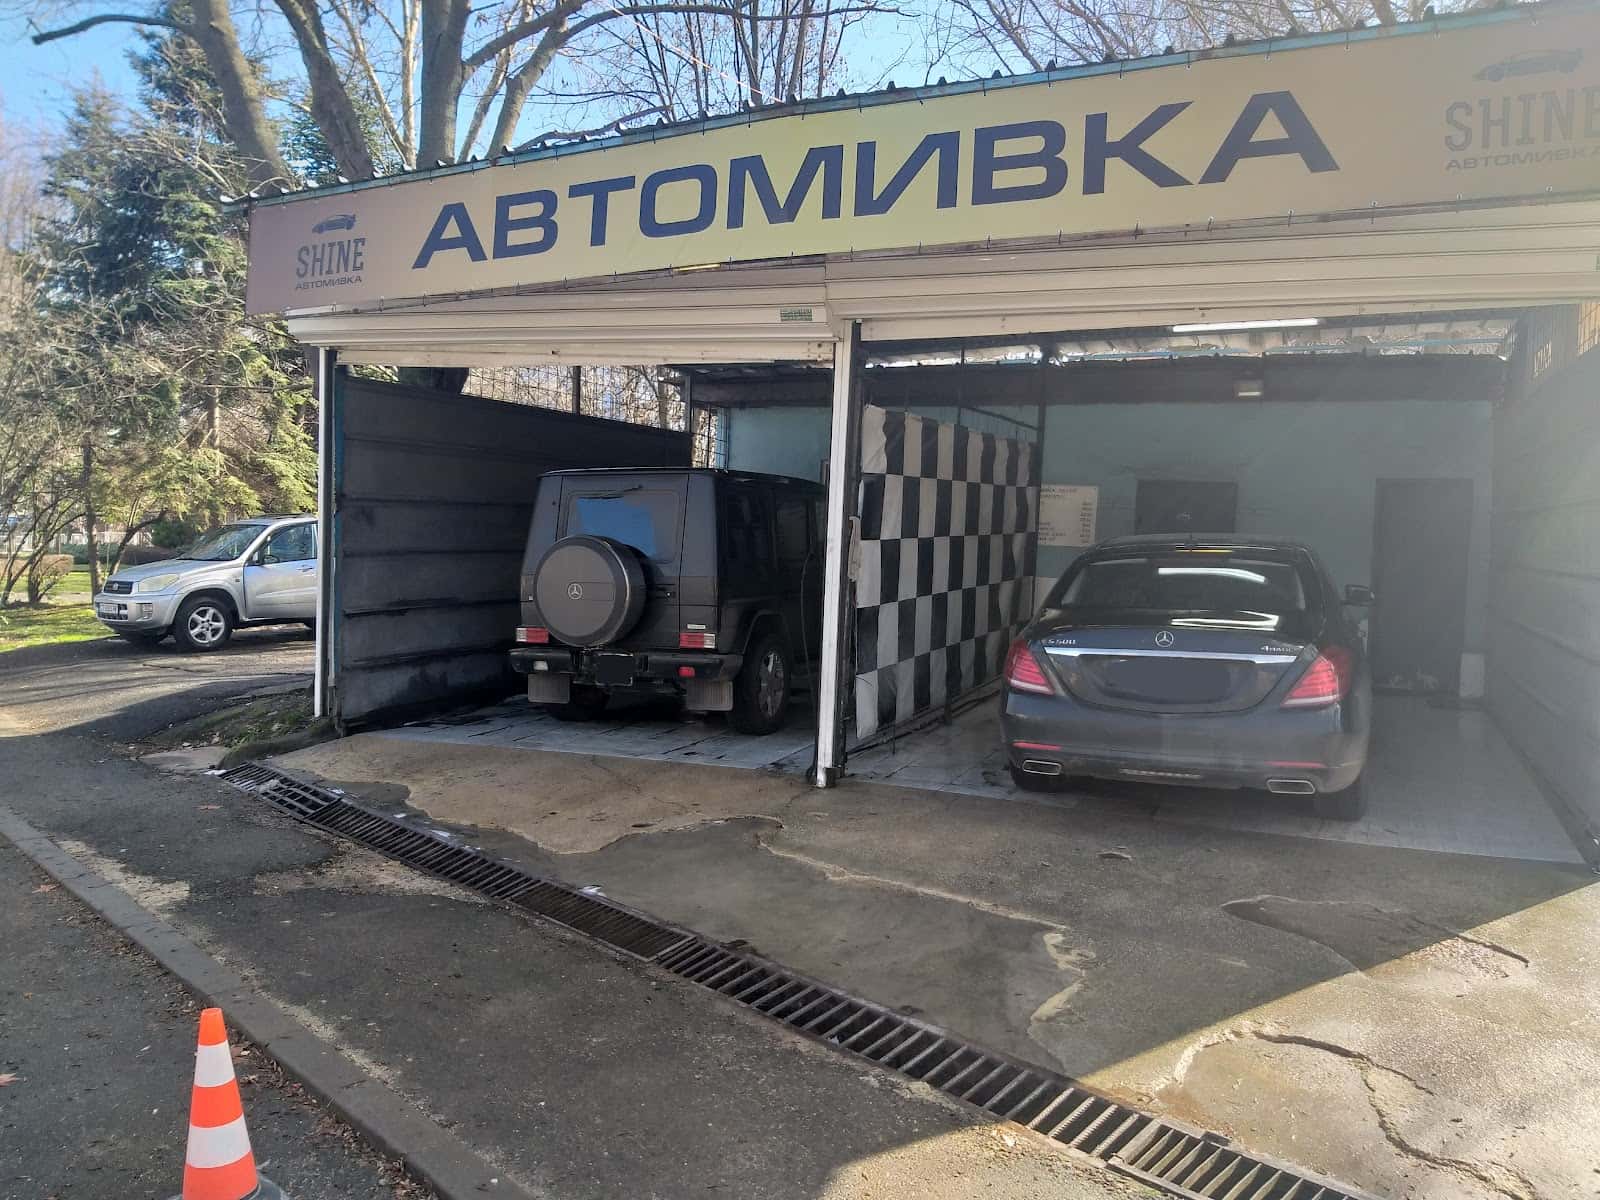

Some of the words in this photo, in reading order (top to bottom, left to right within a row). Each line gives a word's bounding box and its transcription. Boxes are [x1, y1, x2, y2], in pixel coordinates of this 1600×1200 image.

[411, 91, 1339, 269] АВТОМИВКА
[296, 238, 366, 279] SHINE
[295, 275, 362, 291] АВТОМИВКА
